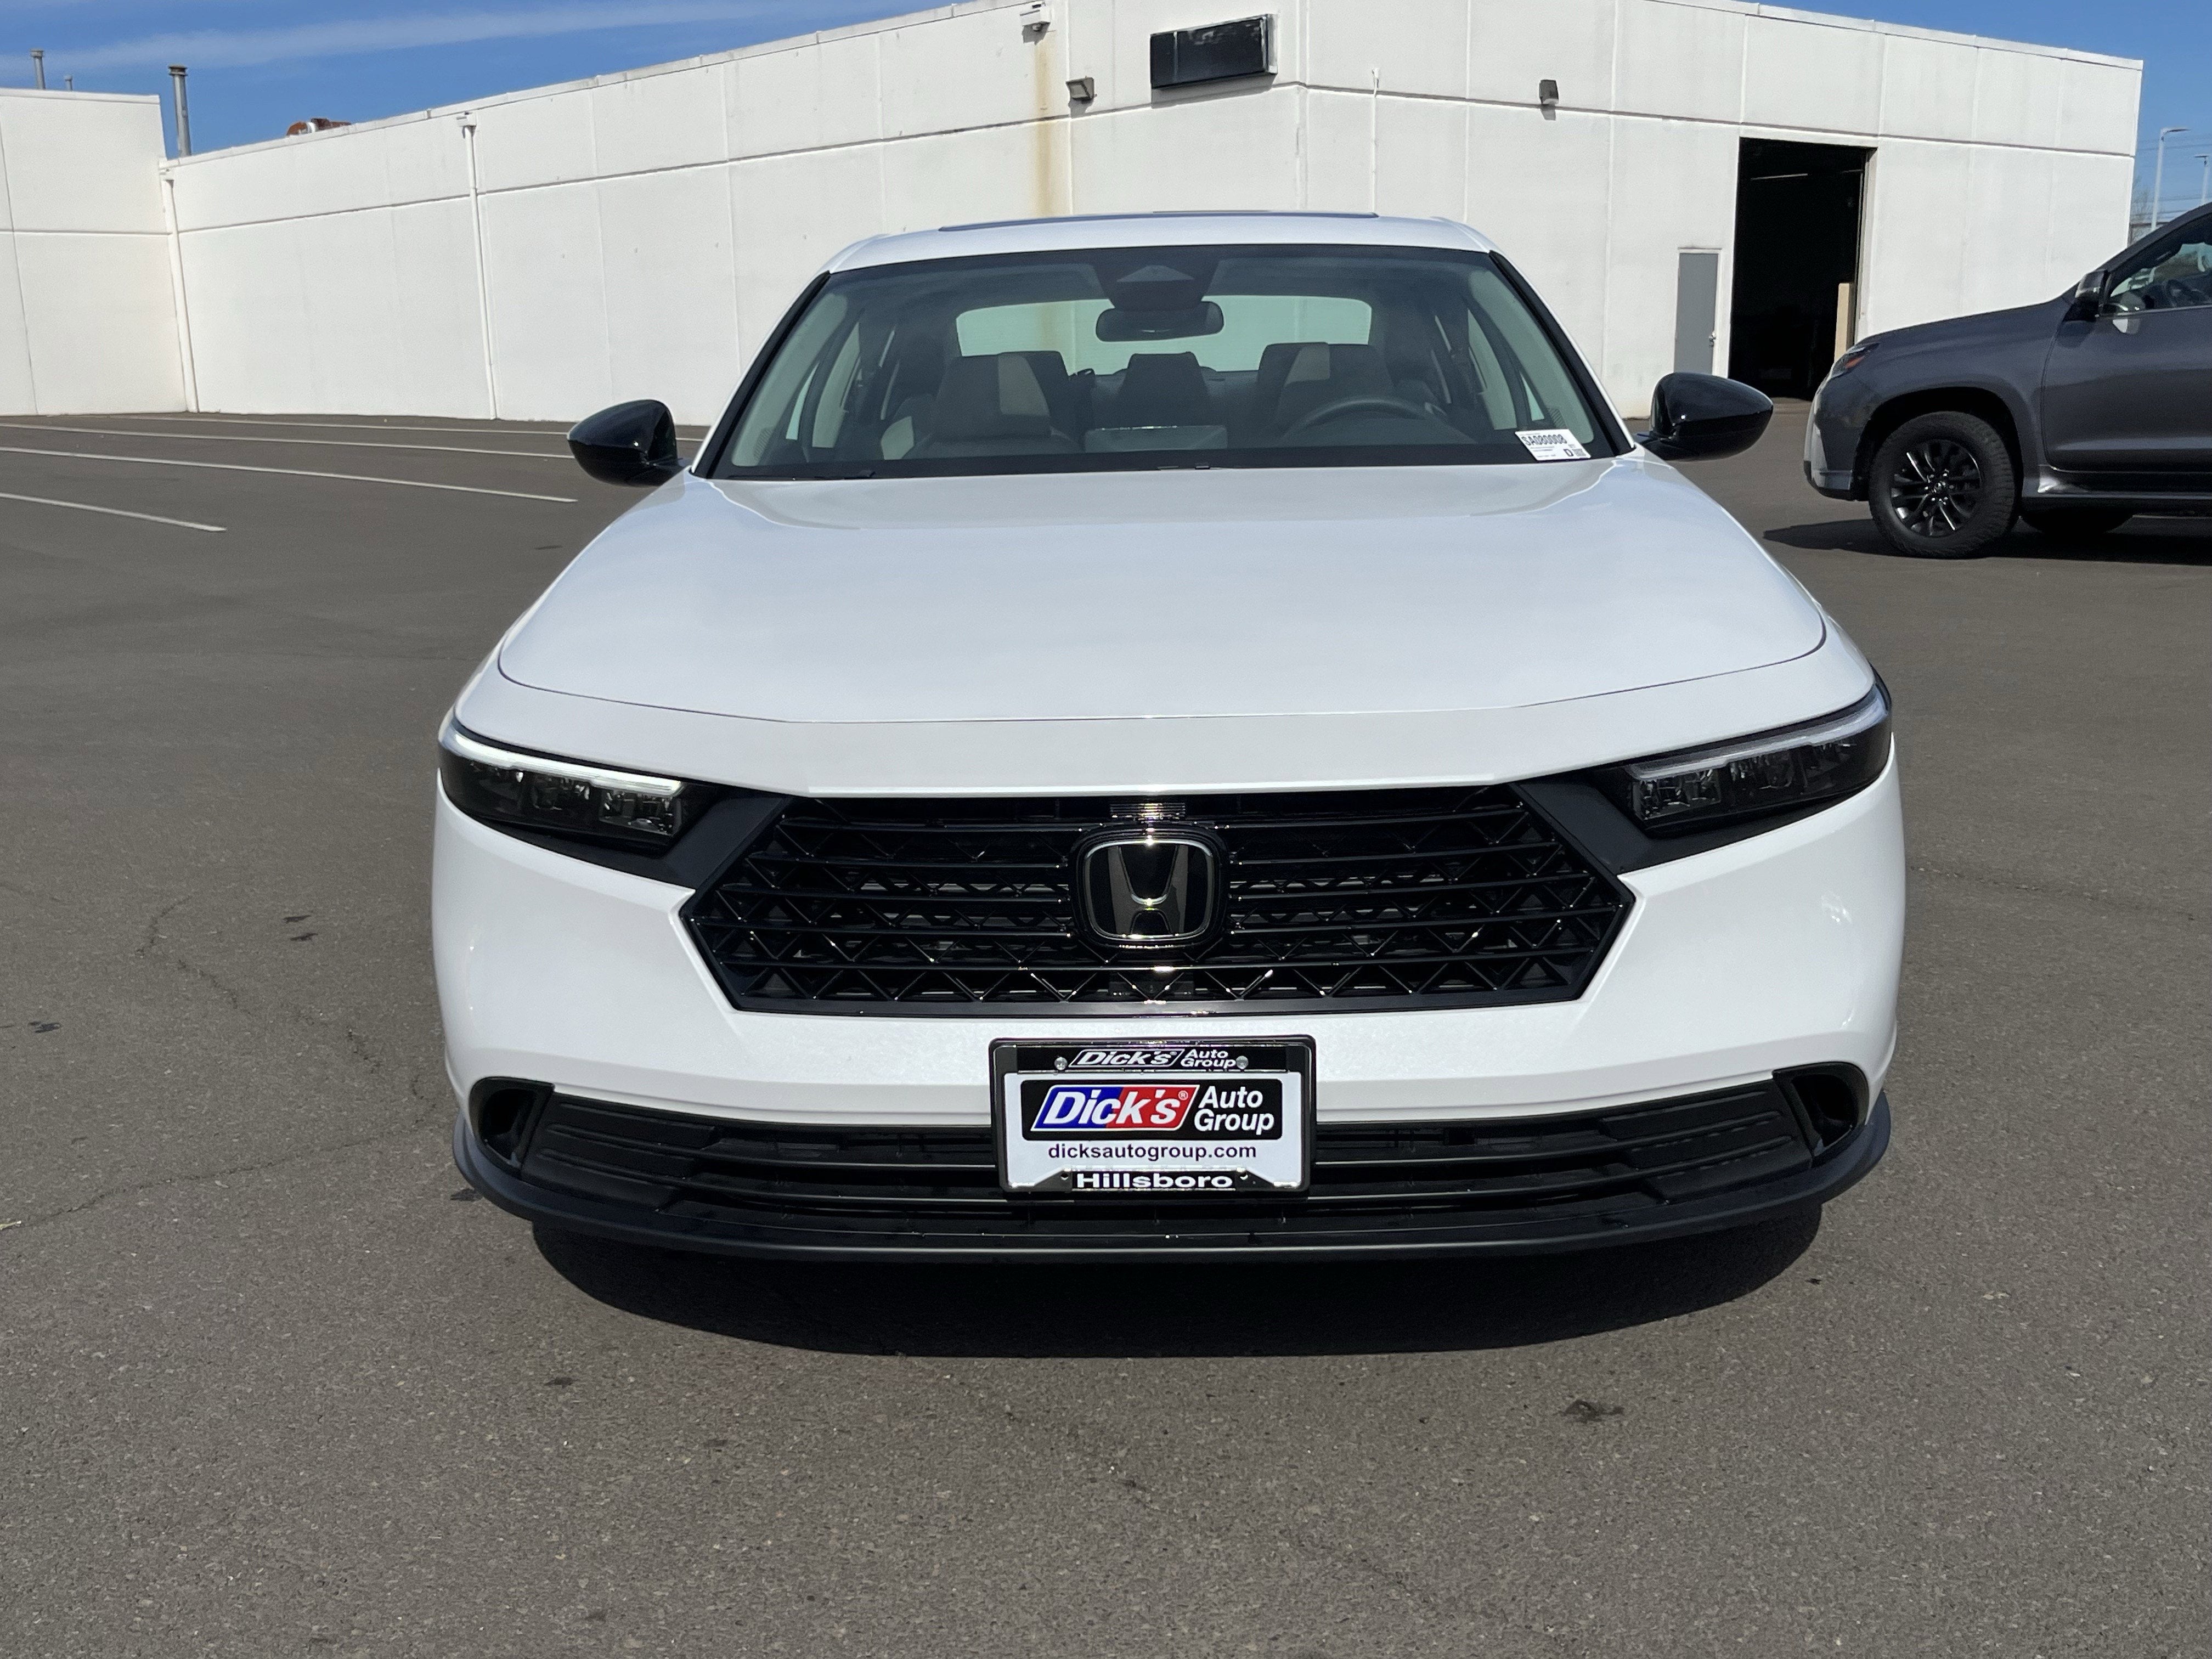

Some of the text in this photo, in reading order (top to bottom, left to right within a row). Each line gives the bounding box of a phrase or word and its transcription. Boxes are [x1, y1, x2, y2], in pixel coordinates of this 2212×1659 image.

[1077, 1048, 1229, 1065] Dick's Auto
[1180, 1058, 1236, 1068] Group
[1043, 1086, 1263, 1125] Dick's Auto
[1194, 1108, 1274, 1135] Group
[1048, 1143, 1256, 1161] dicksautogroup.com
[1076, 1173, 1233, 1188] Hillsboro
